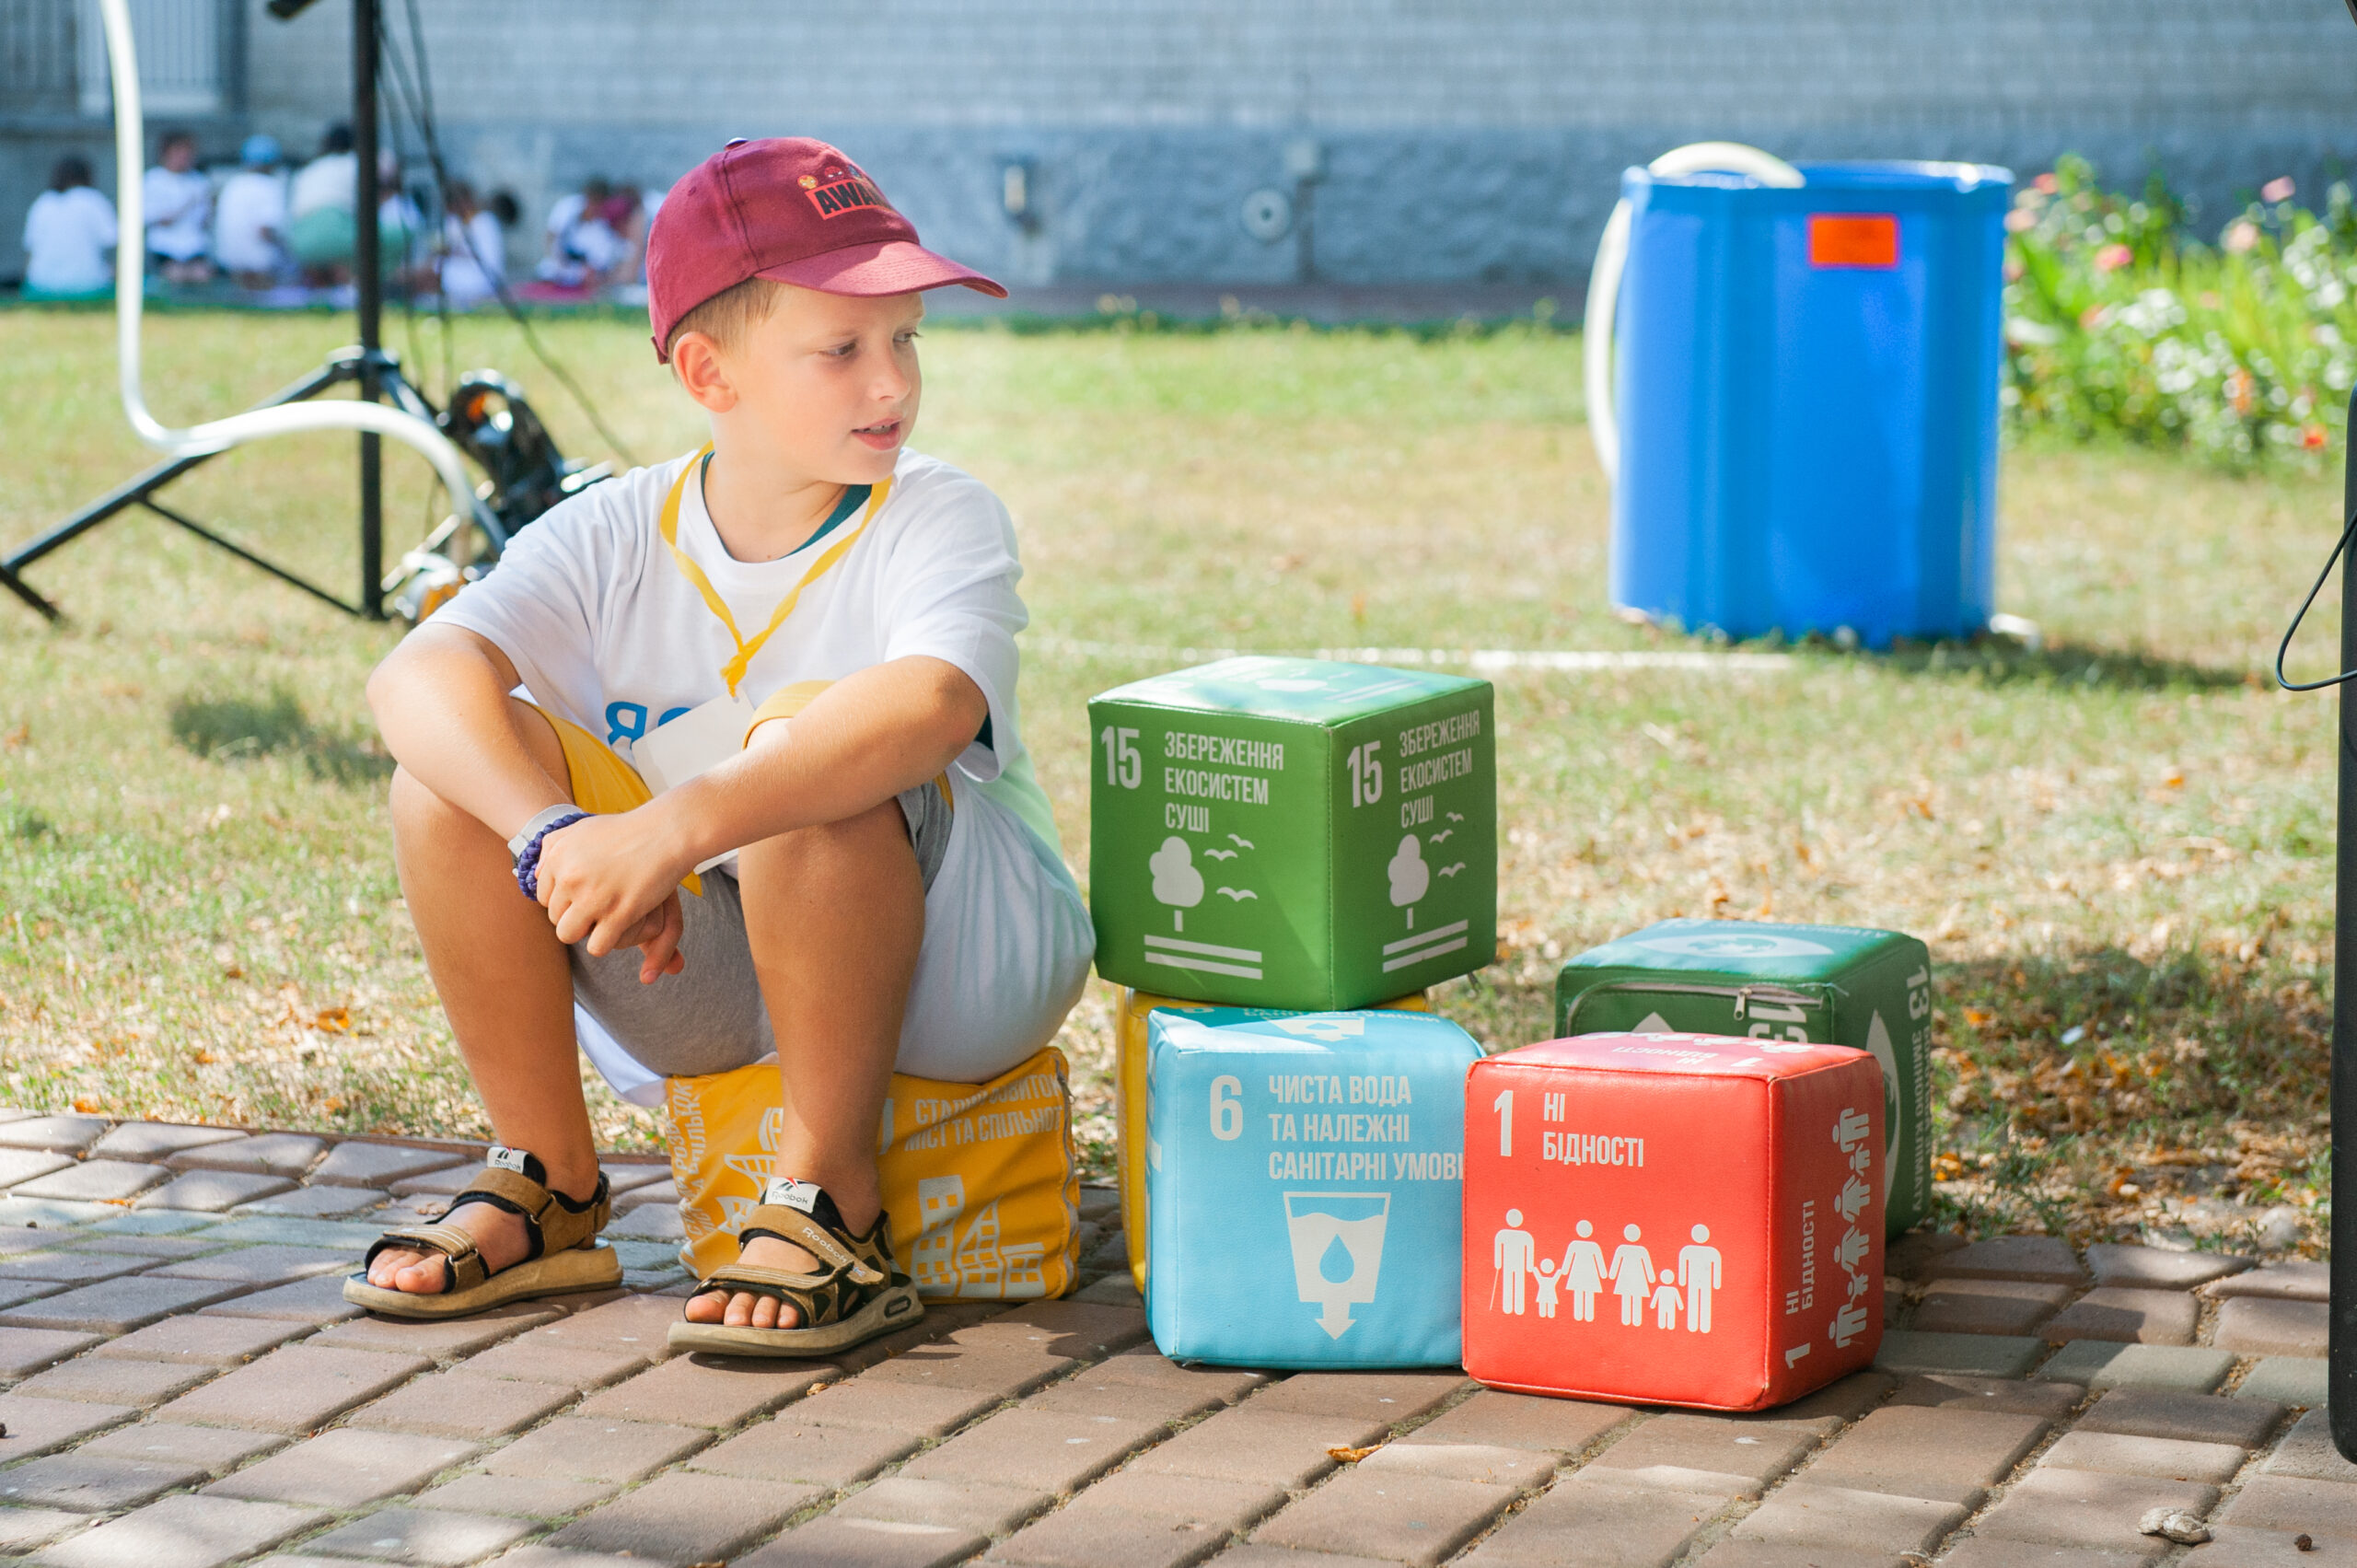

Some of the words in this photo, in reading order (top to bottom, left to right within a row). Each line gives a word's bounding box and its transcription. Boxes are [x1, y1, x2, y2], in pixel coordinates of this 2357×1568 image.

[1165, 731, 1284, 771] ЗБЕРЕЖЕННЯ
[1399, 709, 1480, 758] ЗБЕРЕЖЕННЯ
[1101, 726, 1143, 790] 15
[1347, 740, 1383, 808] 15
[1400, 748, 1473, 794] ЕКОСИСТЕМ
[1165, 767, 1269, 806] ЕКОСИСТЕМ
[1165, 803, 1210, 833] СУШІ
[1401, 795, 1434, 829] СУШІ
[1906, 965, 1930, 1020] 13
[1209, 1074, 1244, 1141] 6
[1269, 1075, 1343, 1104] ЧИСТА
[1349, 1075, 1412, 1108] ВОДА
[1543, 1093, 1565, 1122] НІ
[951, 1117, 975, 1146] ТА
[1269, 1114, 1296, 1142] ТА
[1304, 1114, 1410, 1142] НАЛЕЖНІ
[1494, 1090, 1514, 1157] 1
[1269, 1153, 1387, 1180] САНІТАРНІ
[1543, 1132, 1644, 1167] БІДНОСТІ
[1802, 1200, 1815, 1309] БІДНОСТІ
[1786, 1290, 1799, 1315] НІ
[1785, 1342, 1810, 1369] 1
